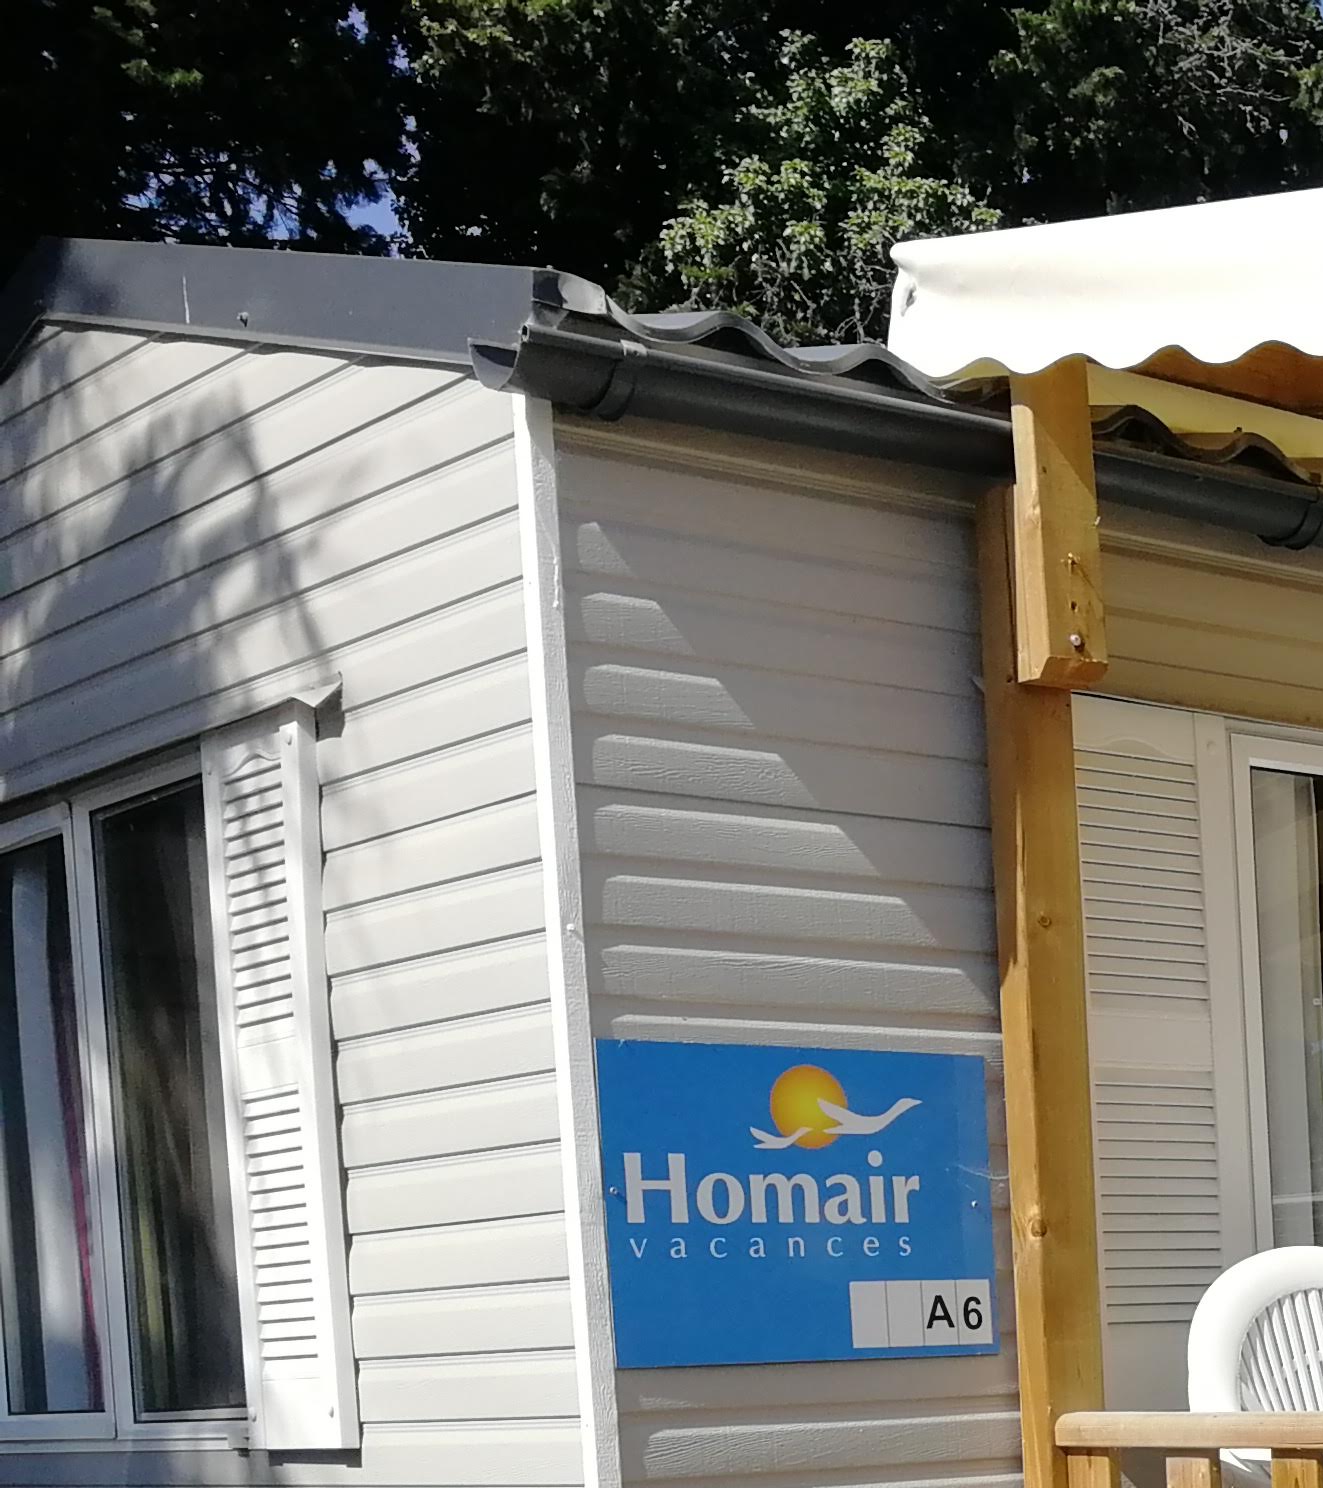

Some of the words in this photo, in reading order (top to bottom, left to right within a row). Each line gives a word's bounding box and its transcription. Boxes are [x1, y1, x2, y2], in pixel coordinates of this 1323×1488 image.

[623, 1150, 920, 1225] Homair
[630, 1235, 912, 1259] vacances
[926, 1295, 984, 1331] A6
